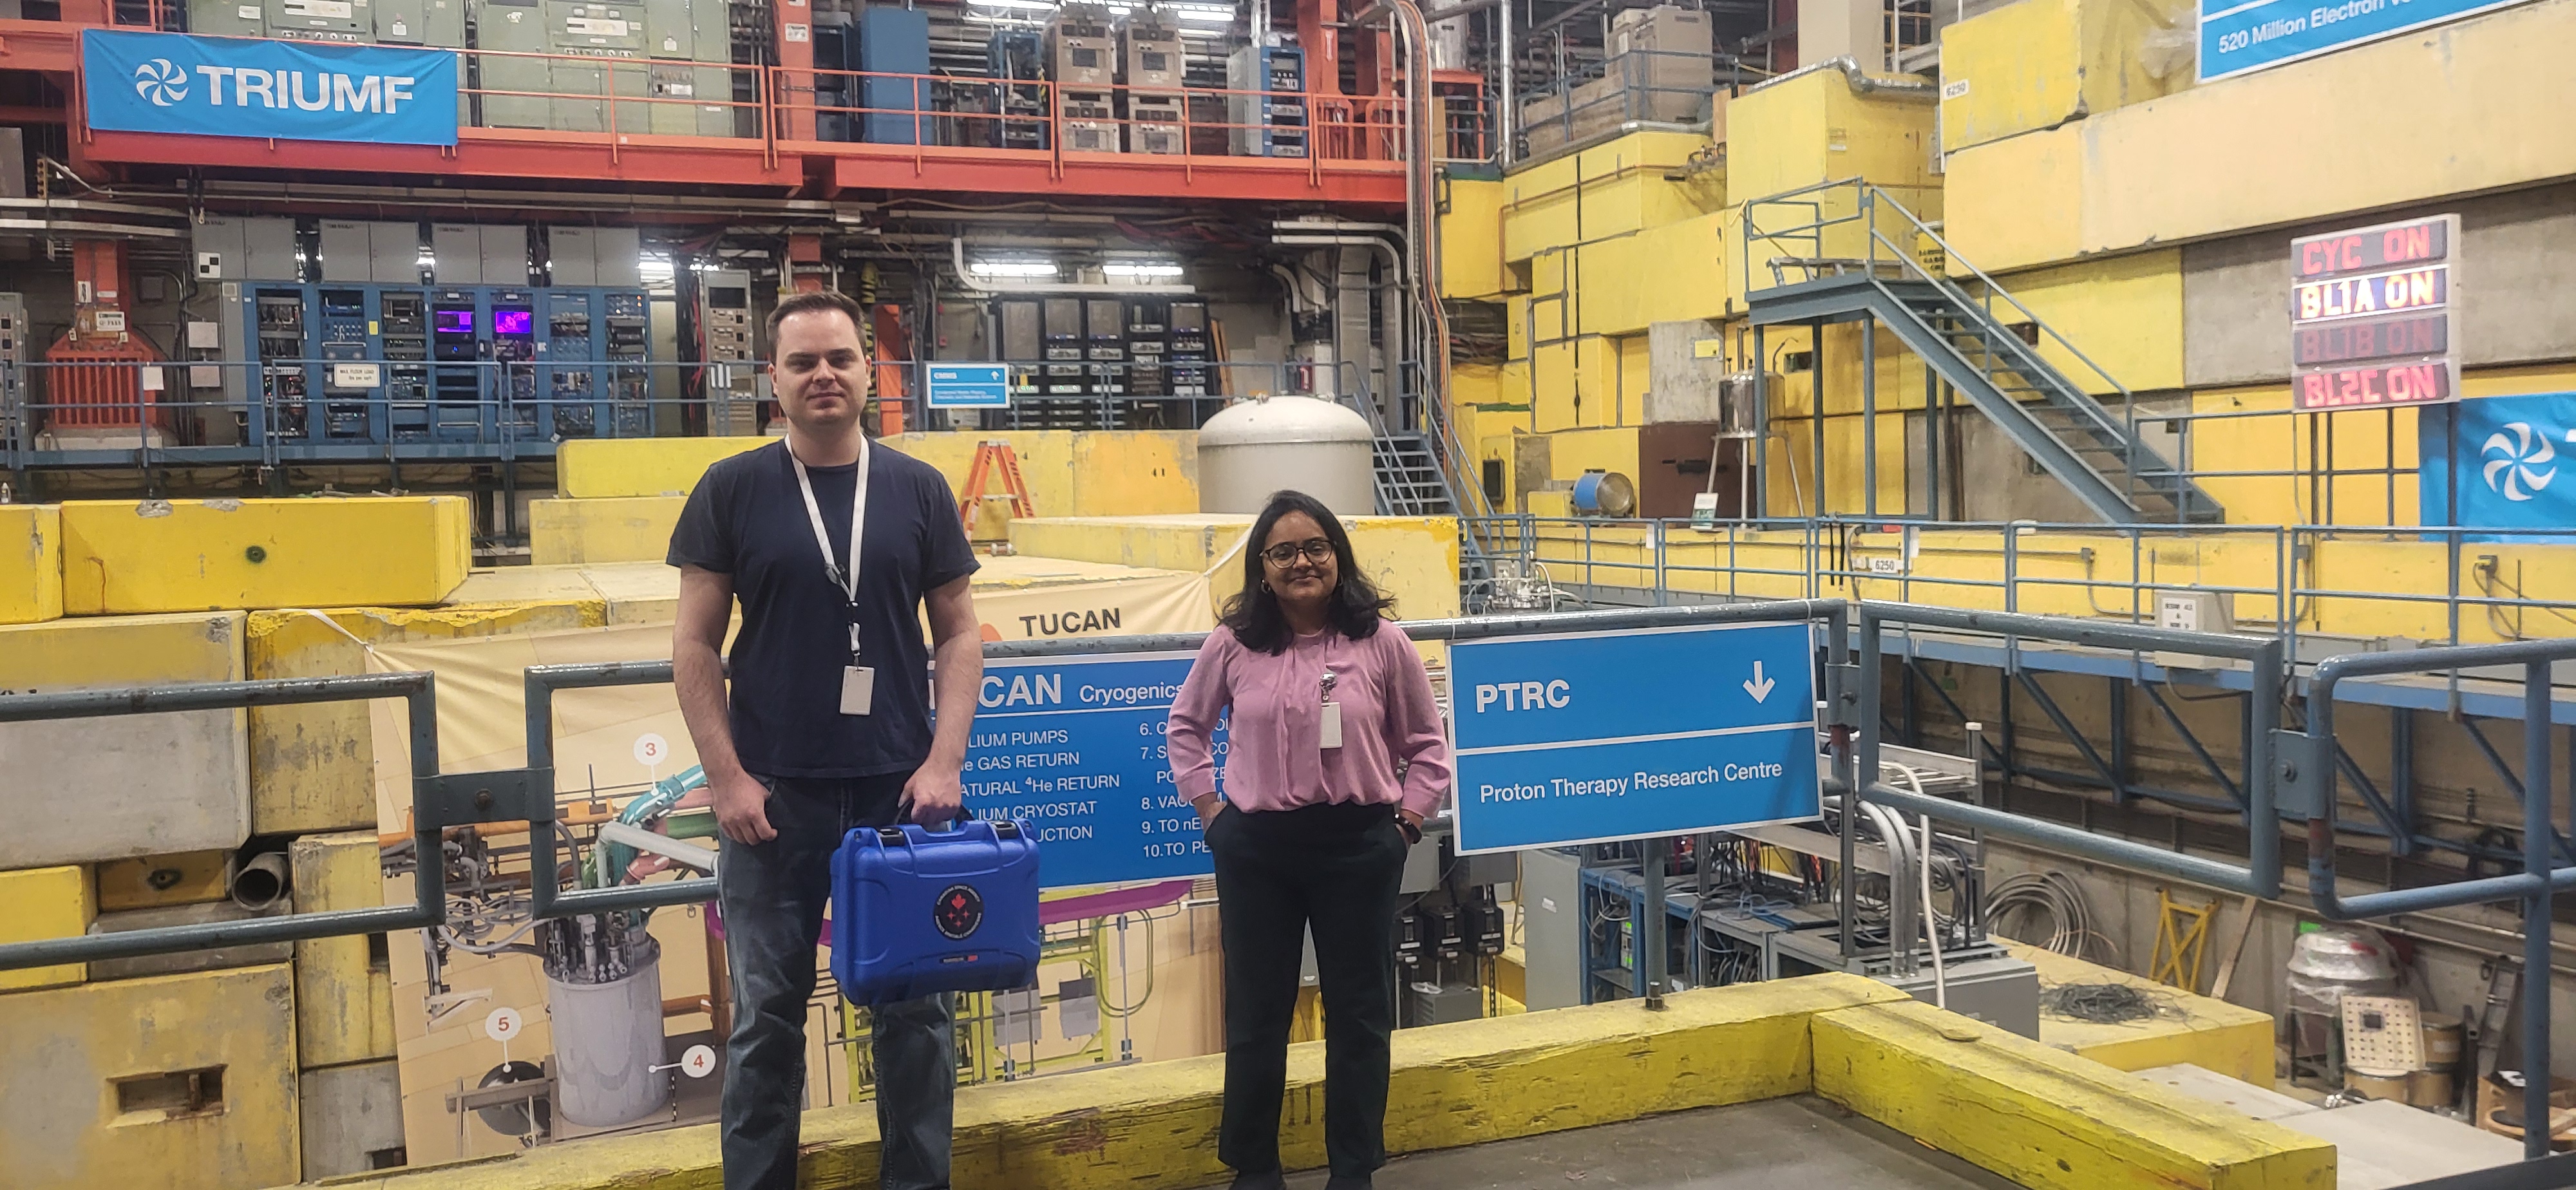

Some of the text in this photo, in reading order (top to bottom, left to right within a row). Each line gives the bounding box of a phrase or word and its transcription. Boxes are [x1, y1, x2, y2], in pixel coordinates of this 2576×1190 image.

[2219, 30, 2248, 54] 520
[2252, 17, 2306, 44] Million
[196, 65, 415, 114] TRIUMF
[2302, 225, 2430, 275] CYC ON
[2300, 270, 2435, 319] BL1A ON
[2302, 319, 2432, 362] BL1B ON
[2304, 364, 2436, 408] BL2C ON
[1875, 560, 1895, 571] 6250
[1019, 608, 1121, 637] TUCAN
[1475, 679, 1571, 713] PTRC
[1139, 722, 1153, 735] 6.
[645, 742, 656, 756] 3
[968, 730, 1068, 748] LIUM PUMPS
[978, 756, 1012, 771] GAS
[1016, 751, 1080, 768] RETURN
[1140, 746, 1153, 760] 7.
[961, 780, 1022, 797] ATURAL
[1057, 774, 1121, 791] RETURN
[1480, 762, 1783, 803] Proton Therapy Research Centre
[1012, 800, 1097, 819] CRYOSTAT
[1141, 797, 1154, 809] 8.
[1142, 817, 1201, 834] 9. TO nE
[498, 1017, 509, 1032] 5
[693, 1054, 704, 1068] 4
